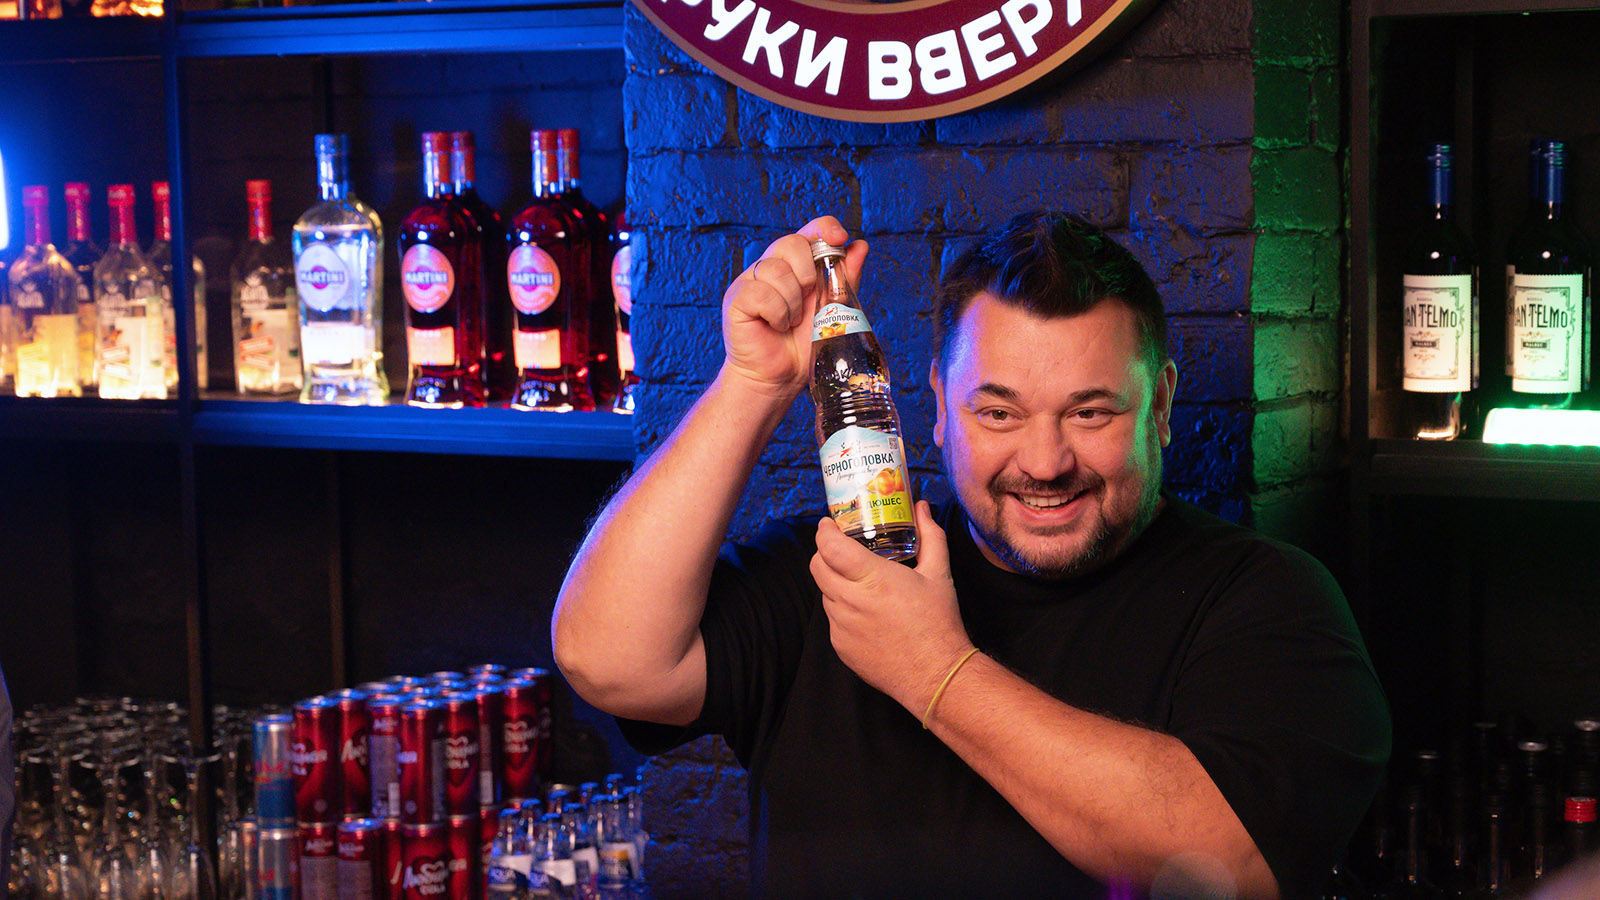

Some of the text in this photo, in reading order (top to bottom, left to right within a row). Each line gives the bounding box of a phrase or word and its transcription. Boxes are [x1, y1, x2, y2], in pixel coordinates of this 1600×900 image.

[659, 0, 848, 96] УКИ
[300, 271, 345, 283] MARTINI
[405, 271, 448, 284] MARTINI
[511, 272, 554, 285] MARTINI
[1418, 304, 1458, 328] TELMO
[1529, 303, 1568, 328] TELMO
[823, 452, 895, 477] ЧЕРНОГОЛОВКА
[866, 497, 902, 509] ДЮШЕС
